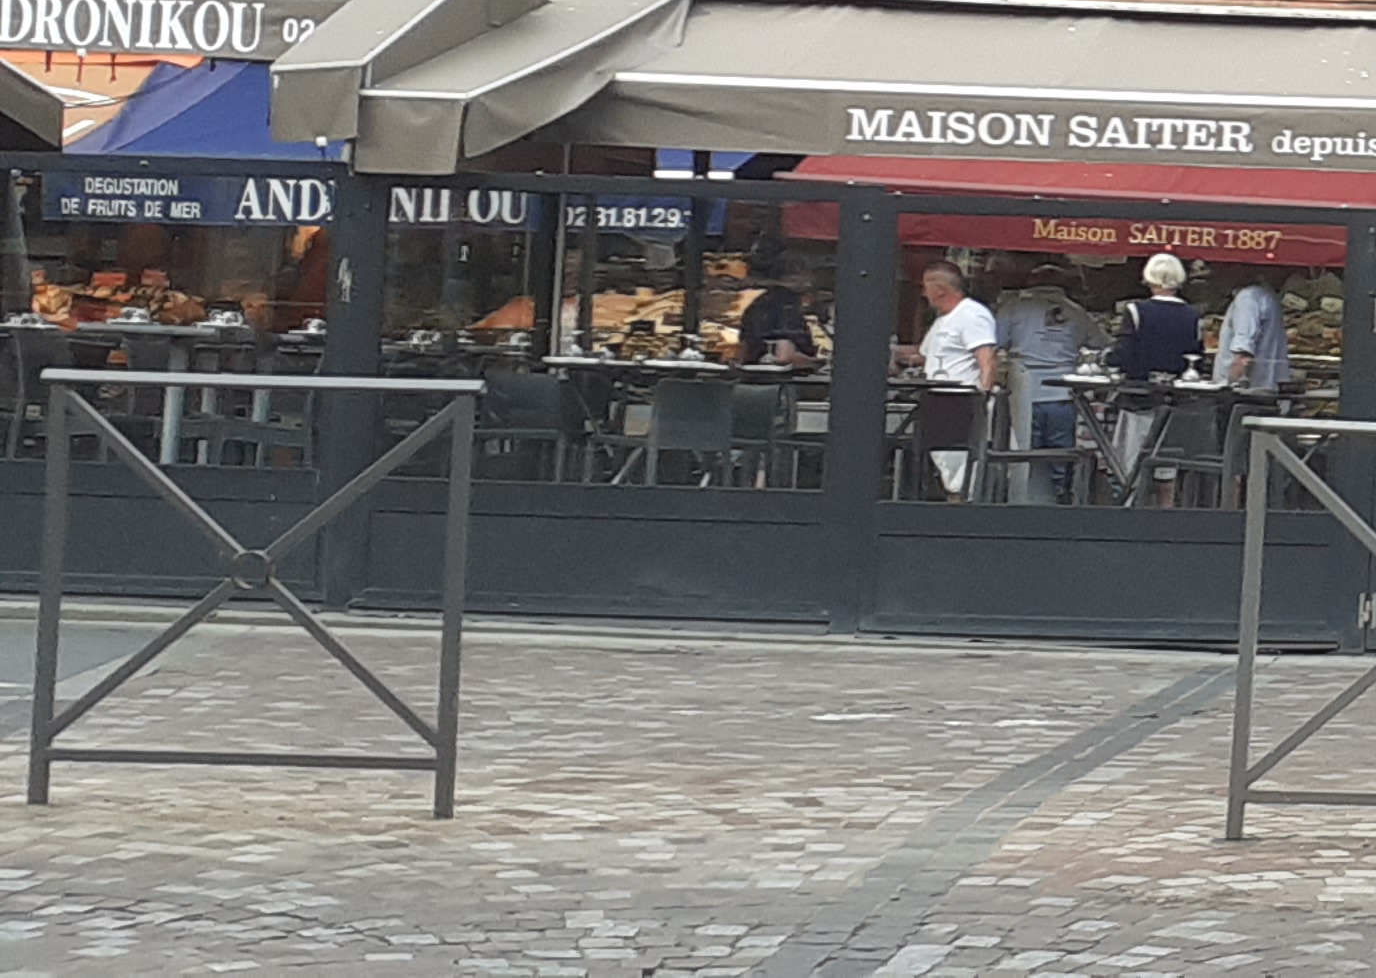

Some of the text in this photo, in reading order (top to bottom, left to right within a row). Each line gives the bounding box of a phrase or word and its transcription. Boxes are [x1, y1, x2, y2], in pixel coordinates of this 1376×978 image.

[845, 108, 1055, 147] MAISON
[1067, 114, 1254, 154] SAITER
[84, 176, 179, 197] DEGUSTATION
[60, 197, 201, 219] DE FRUITS DE MER
[1033, 219, 1281, 250] Maison SAITER 1887
